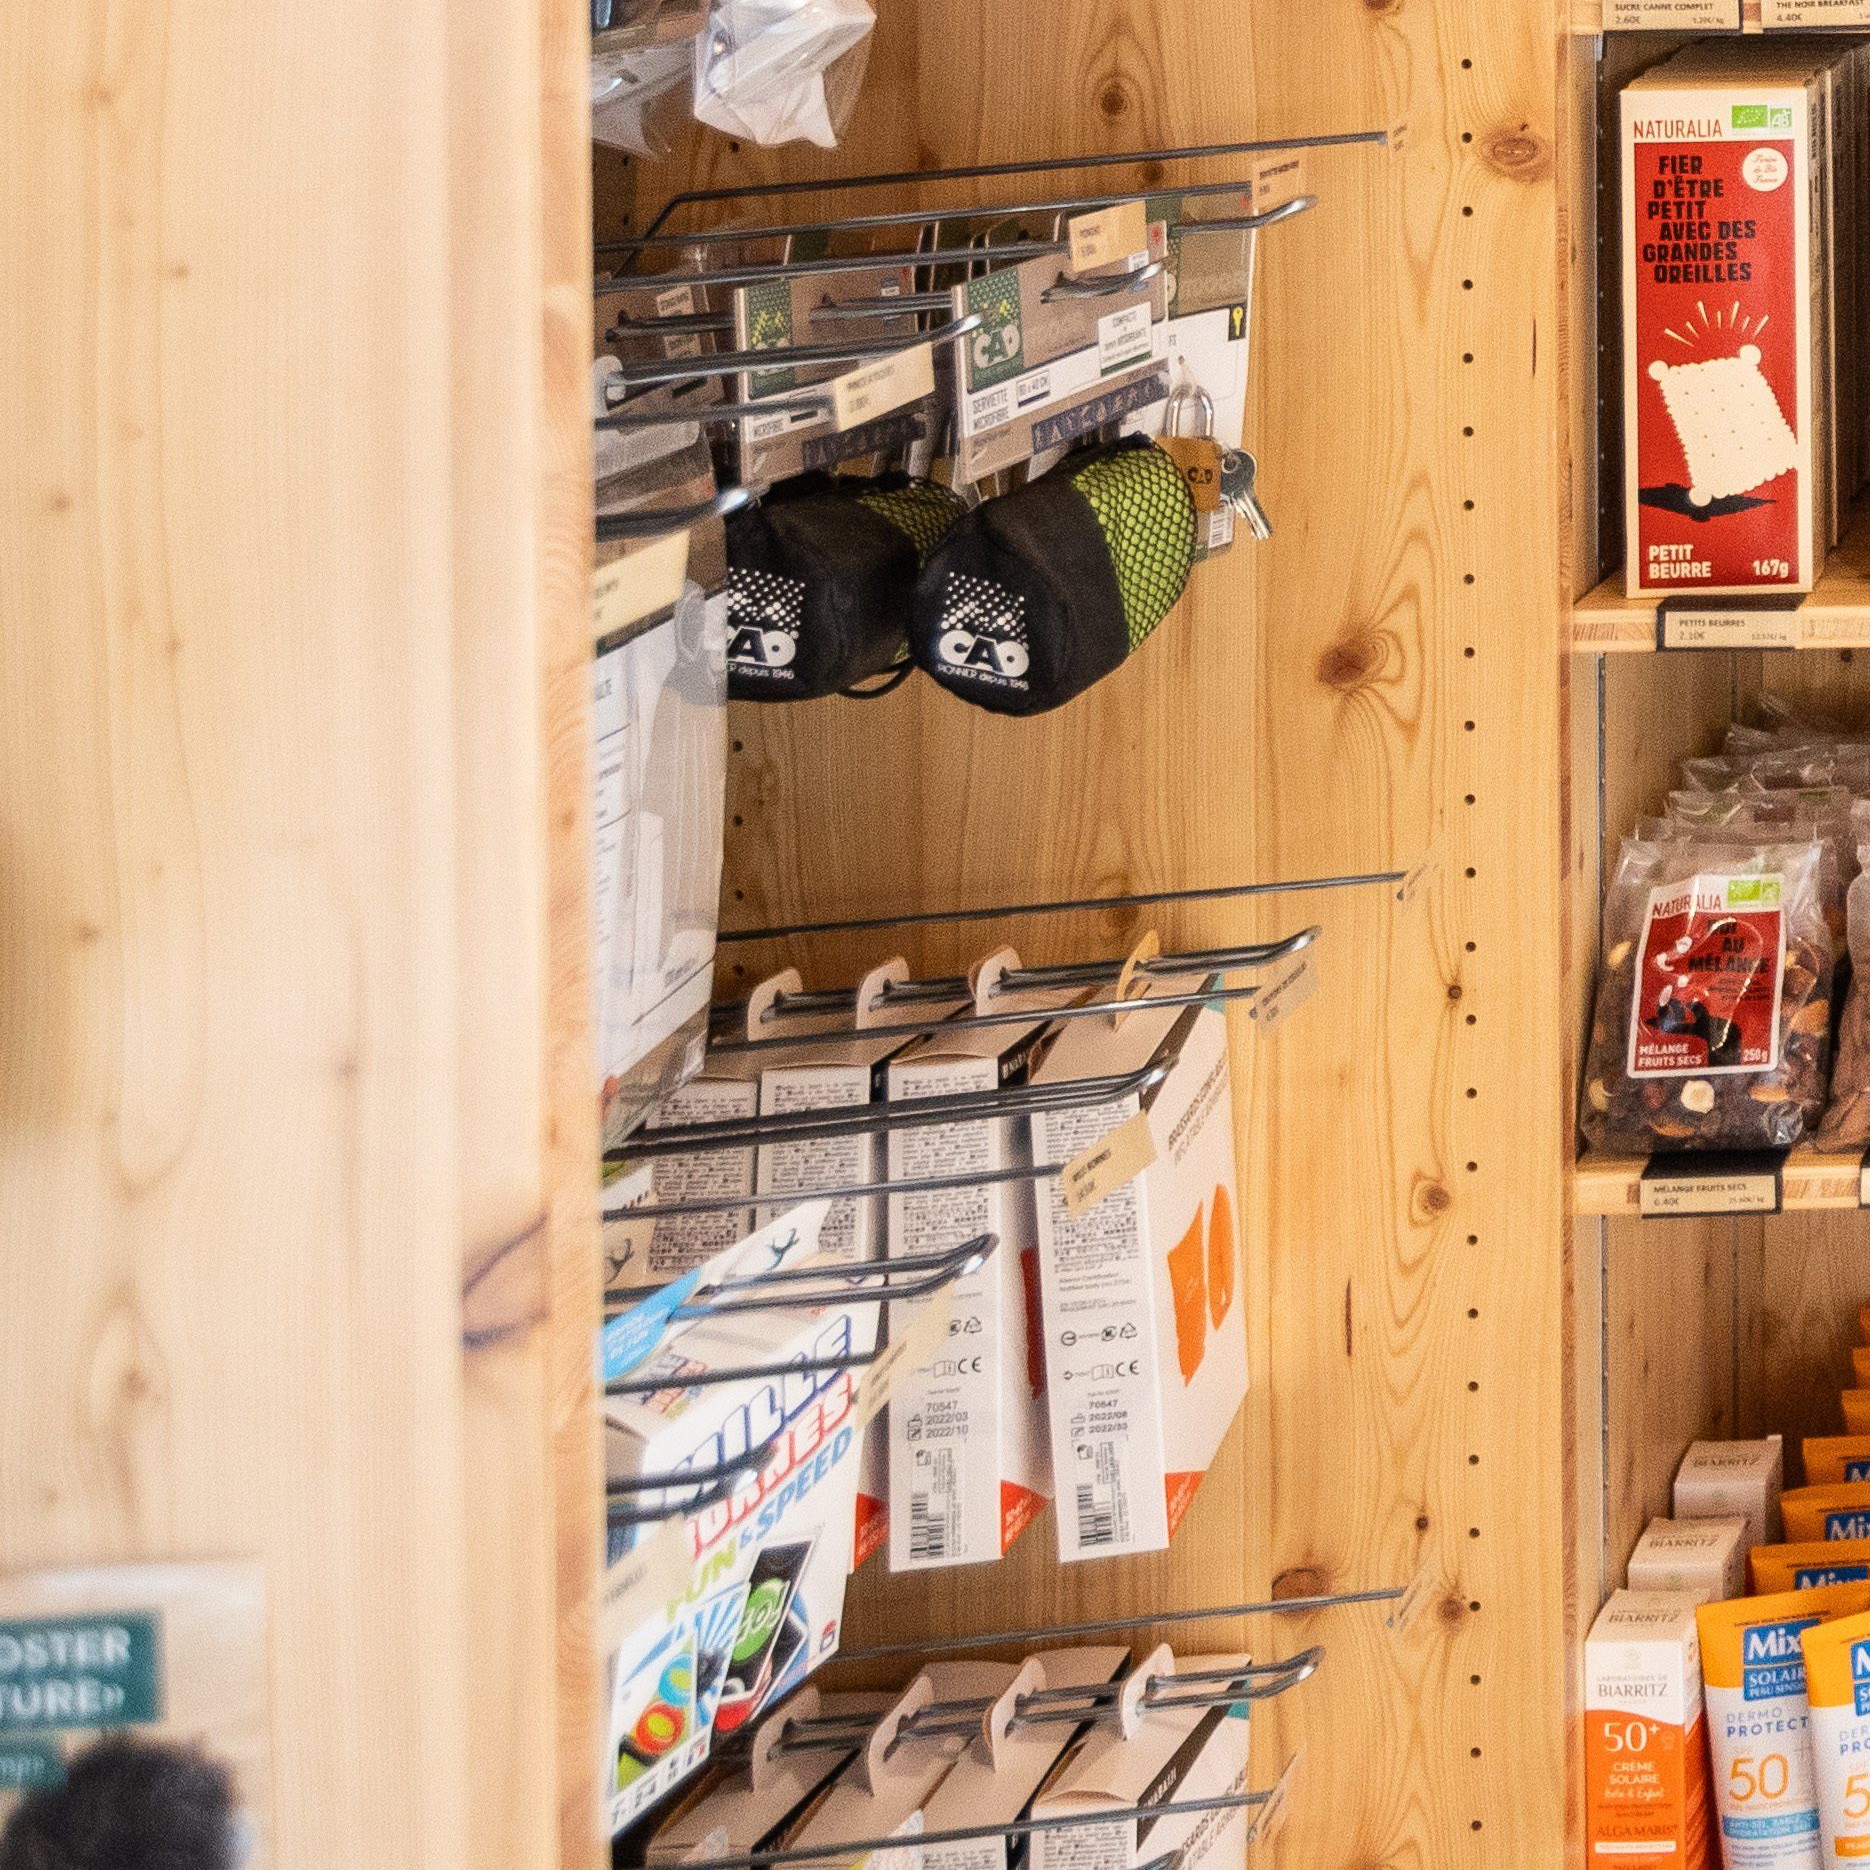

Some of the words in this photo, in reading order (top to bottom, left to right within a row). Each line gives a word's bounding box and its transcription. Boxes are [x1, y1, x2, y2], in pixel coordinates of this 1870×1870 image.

[1633, 119, 1722, 139] NATURALIA
[1648, 199, 1706, 220] PETIT
[1643, 241, 1737, 262] GRANDES
[1654, 262, 1752, 284] OREILLES
[1649, 560, 1712, 580] BEURRE
[1752, 559, 1788, 580] 167g
[1679, 618, 1703, 628] PETITS
[1704, 618, 1746, 628] BEURRES
[939, 628, 1029, 678] CAO
[926, 1411, 968, 1424] 2022/03
[755, 1424, 854, 1542] SPEED
[1599, 1683, 1667, 1698] BIARRITZ
